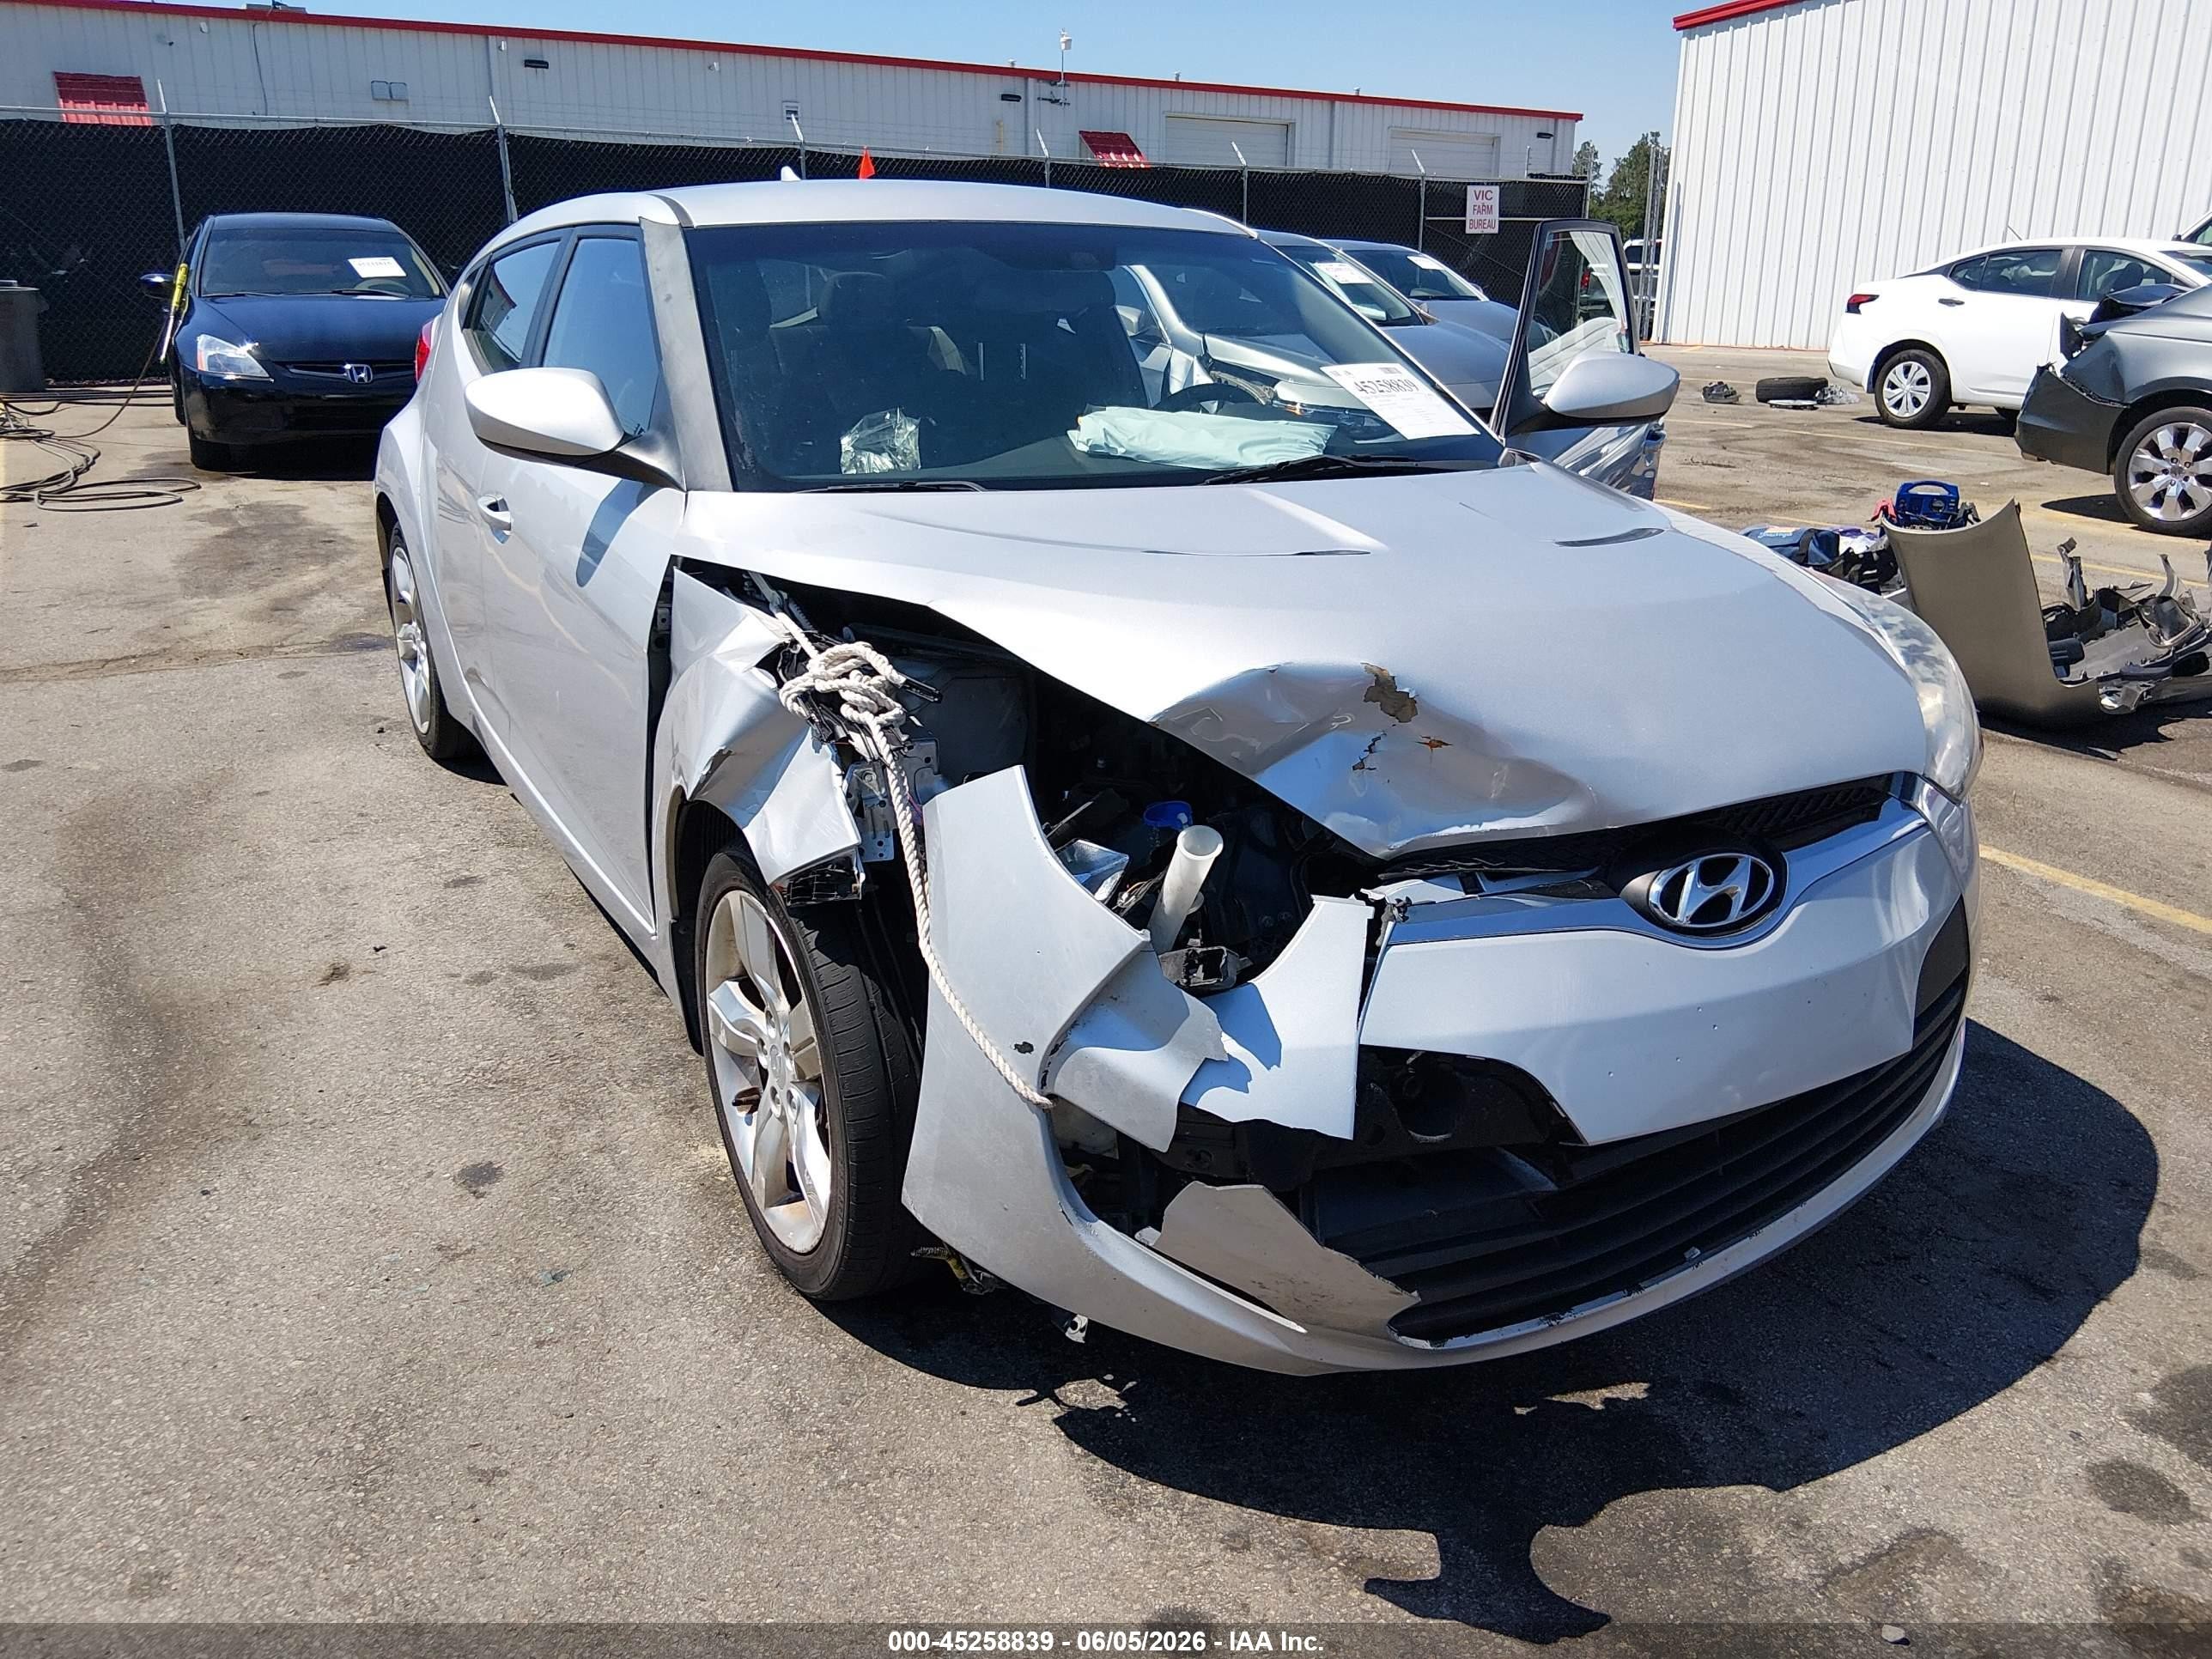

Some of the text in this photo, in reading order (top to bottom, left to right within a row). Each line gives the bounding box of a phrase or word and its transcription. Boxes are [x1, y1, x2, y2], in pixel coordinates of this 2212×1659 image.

[1474, 190, 1493, 201] VIC
[1473, 204, 1493, 216] FARM
[1469, 218, 1496, 230] BUREAU
[1354, 379, 1419, 394] 45258839
